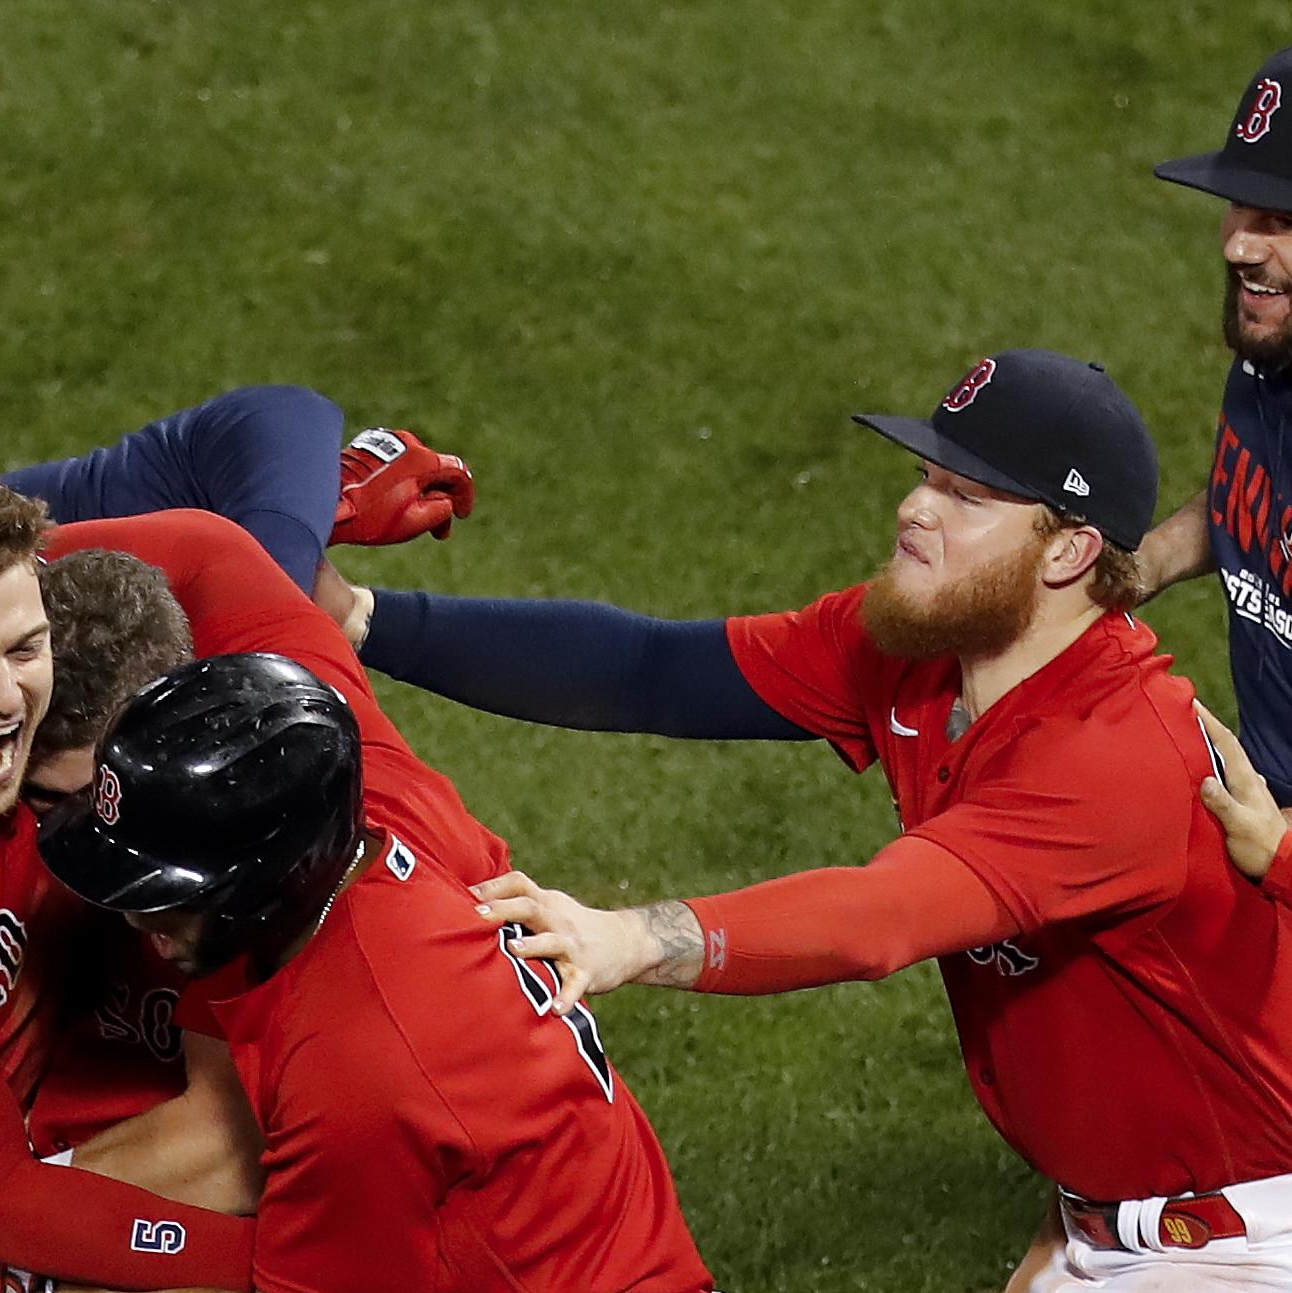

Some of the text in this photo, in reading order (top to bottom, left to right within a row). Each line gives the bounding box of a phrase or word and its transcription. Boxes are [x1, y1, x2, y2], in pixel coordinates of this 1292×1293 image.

[1237, 78, 1281, 143] B
[942, 358, 996, 412] B
[96, 763, 122, 825] B
[131, 1219, 186, 1254] 5
[1163, 1218, 1192, 1244] 99
